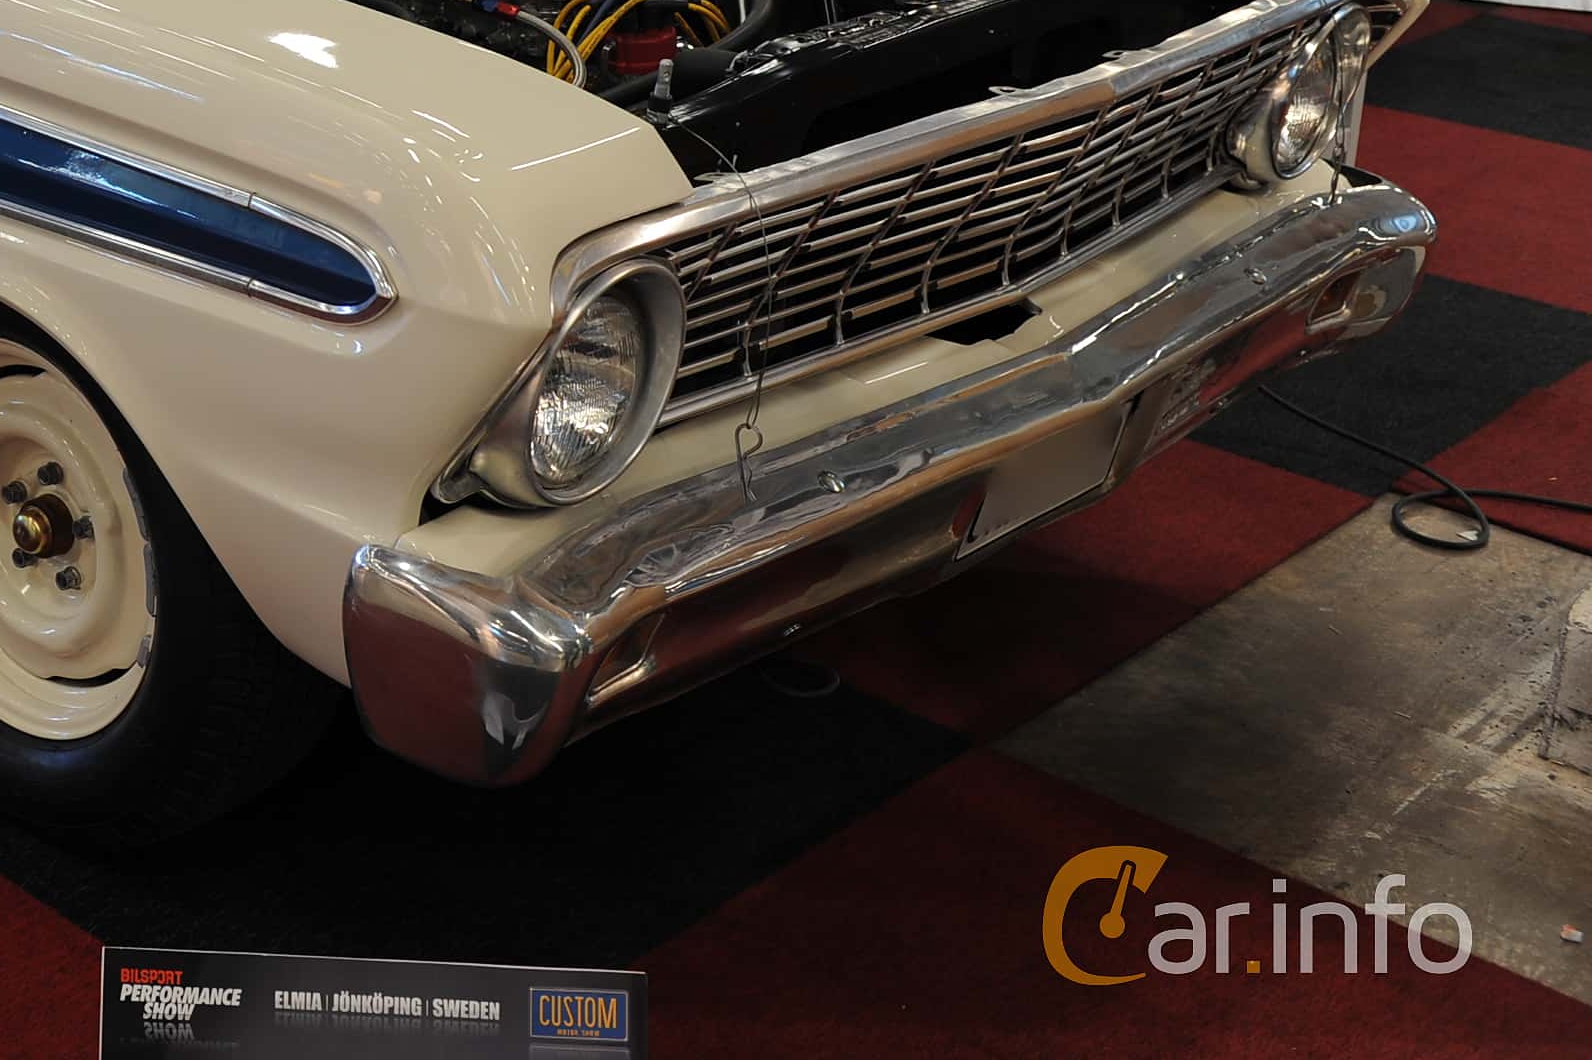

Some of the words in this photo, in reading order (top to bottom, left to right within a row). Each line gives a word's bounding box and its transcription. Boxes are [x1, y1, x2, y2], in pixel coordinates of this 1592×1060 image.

[120, 968, 183, 985] BILSPORT
[120, 983, 242, 1006] PERFORMANCE
[274, 990, 322, 1011] ELMIA
[332, 989, 422, 1017] JÖNKÖPING
[433, 997, 500, 1021] SWEDEN
[143, 1002, 196, 1021] SHOW
[539, 994, 617, 1029] CUSTOM
